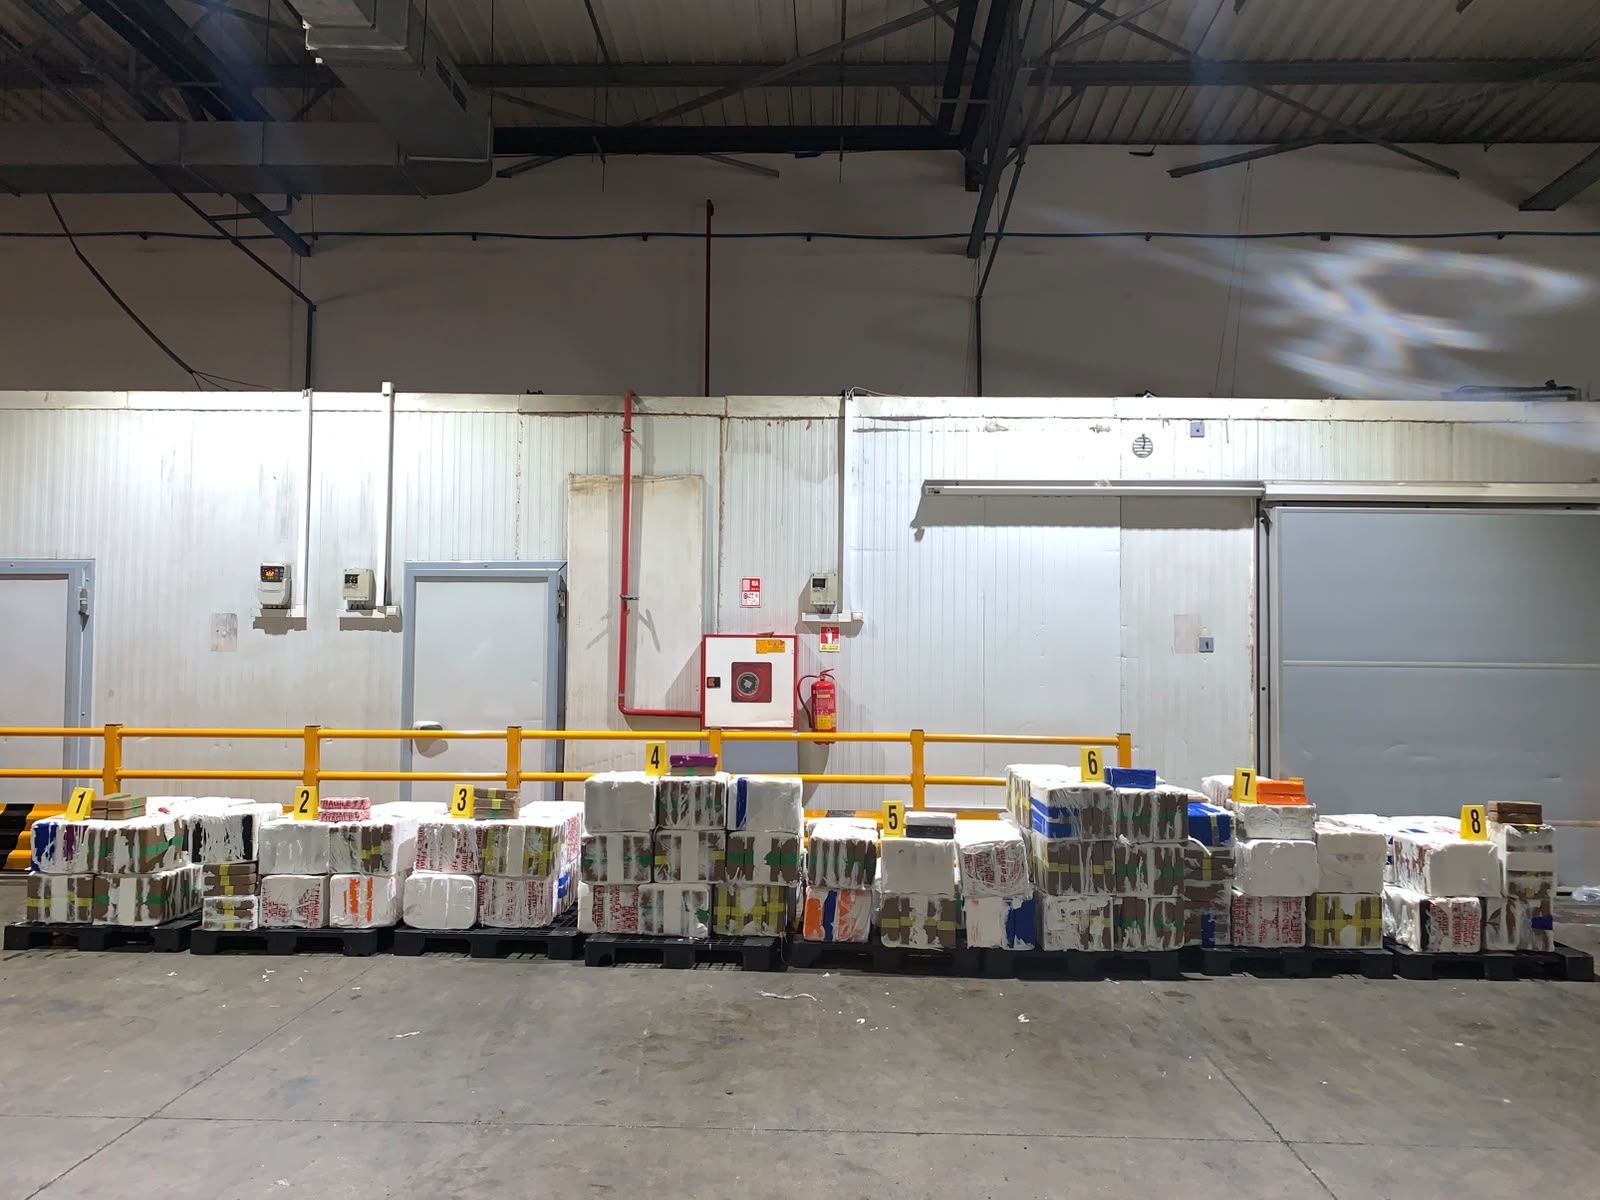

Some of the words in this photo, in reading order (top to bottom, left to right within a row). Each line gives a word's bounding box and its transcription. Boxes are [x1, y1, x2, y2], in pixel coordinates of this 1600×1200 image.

[651, 745, 660, 769] 4
[1088, 750, 1098, 775] 6
[1242, 772, 1251, 796] 7
[76, 791, 87, 814] 1
[299, 790, 310, 813] 2
[457, 788, 467, 811] 3
[888, 805, 898, 830] 5
[1471, 809, 1481, 834] 8
